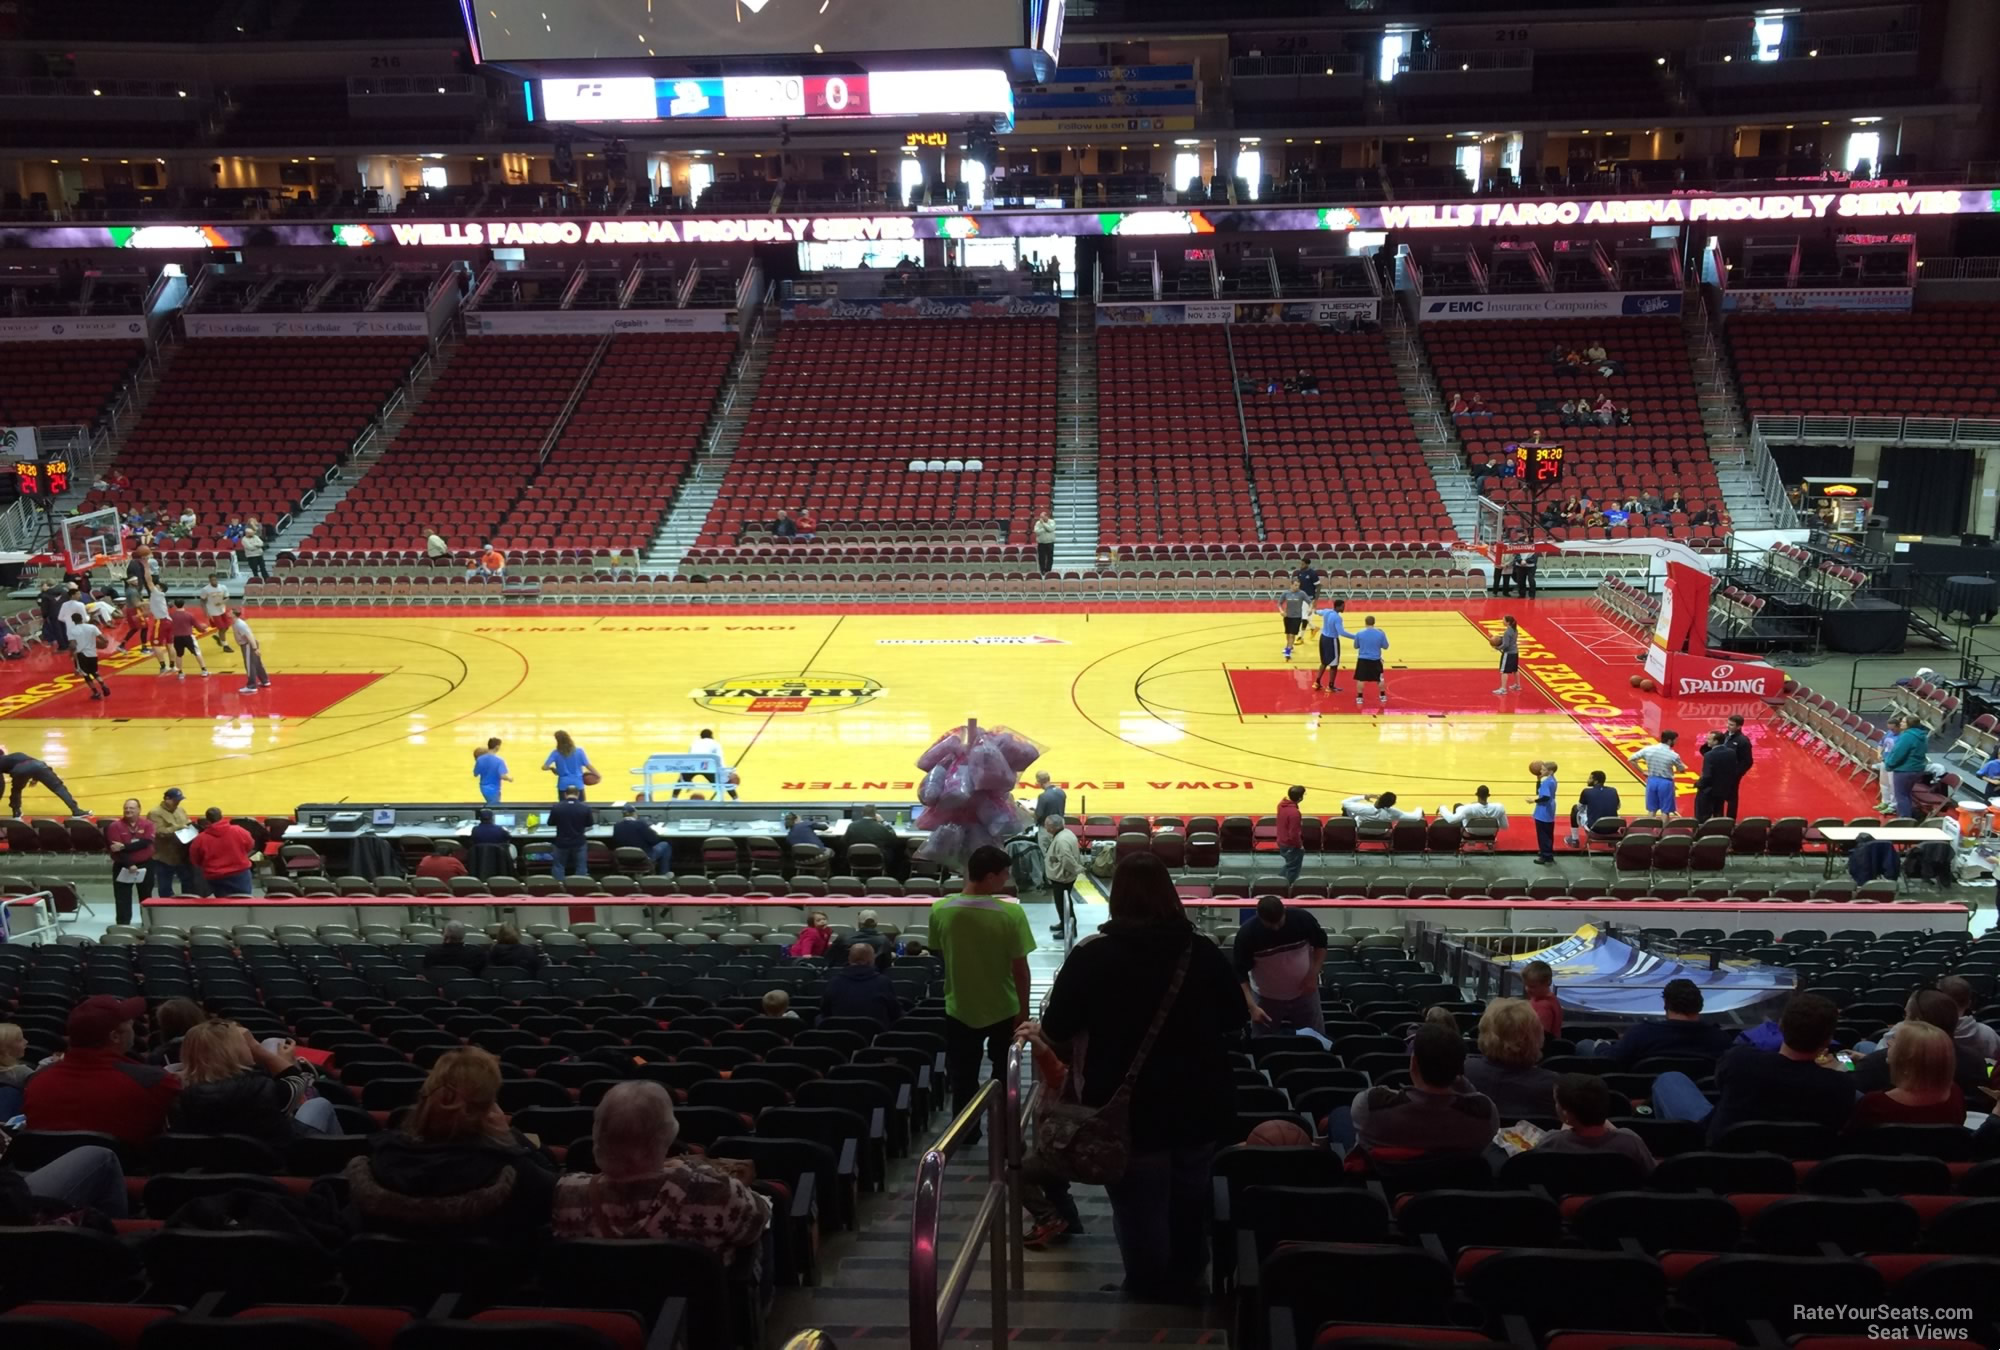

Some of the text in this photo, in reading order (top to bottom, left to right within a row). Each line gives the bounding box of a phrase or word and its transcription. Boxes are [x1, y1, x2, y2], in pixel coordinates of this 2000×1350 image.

[1495, 30, 1528, 42] 219
[1380, 191, 1962, 228] WELLS FARGO ARENA PROUDLY SERVES
[391, 217, 915, 245] WELLS FARGO ARENA PROUDLY SERVES
[832, 306, 870, 317] LIGHT
[920, 306, 960, 317] LIGHT
[1008, 304, 1047, 315] LIGHT
[1320, 303, 1373, 311] TUESDAY
[1449, 299, 1608, 313] EMC Insurance Companies
[1536, 448, 1563, 462] 39:20
[16, 463, 37, 476] 39:20
[46, 461, 66, 476] 39:20
[1538, 460, 1559, 480] 24
[703, 688, 880, 698] ARENA
[1525, 663, 1623, 717] FARGO
[1679, 678, 1765, 695] SPALDING
[1147, 782, 1254, 790] IOWA
